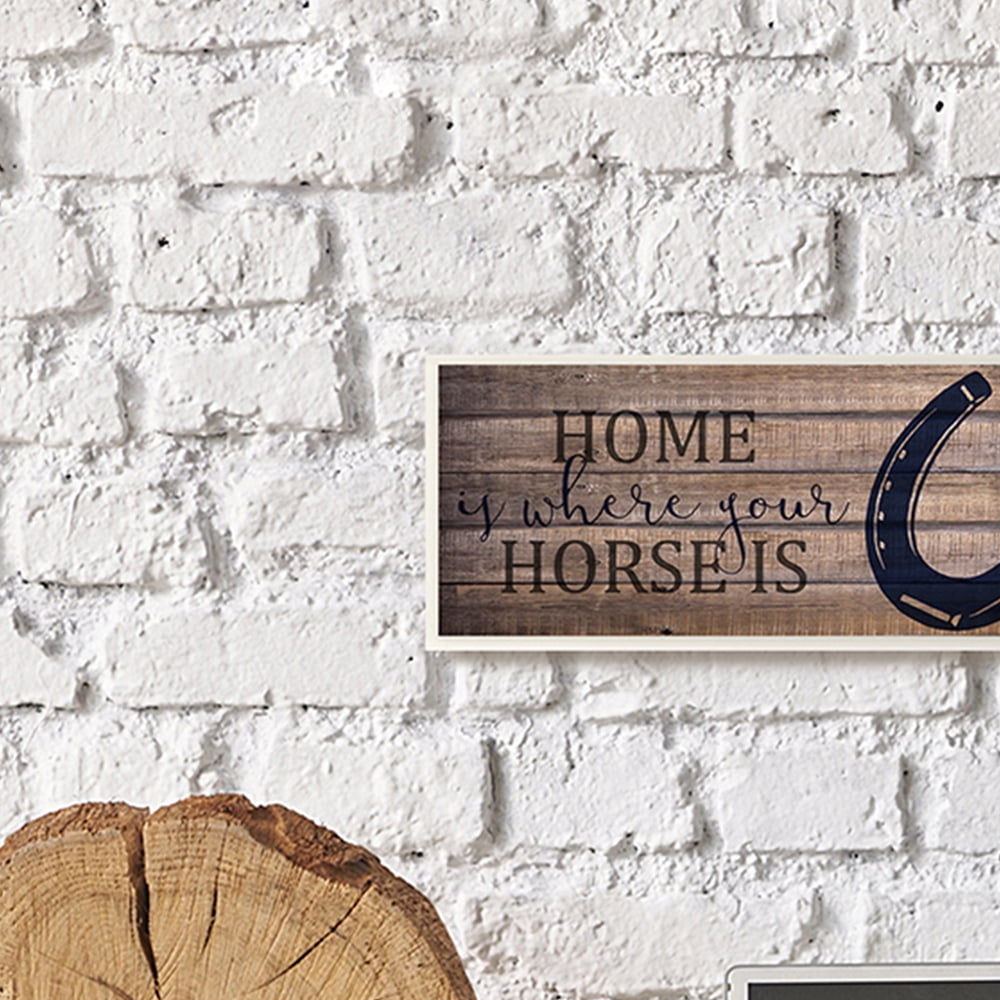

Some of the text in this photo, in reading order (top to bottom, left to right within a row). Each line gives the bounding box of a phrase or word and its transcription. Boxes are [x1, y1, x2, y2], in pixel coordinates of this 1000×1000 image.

[553, 409, 756, 464] HOME
[457, 453, 851, 575] is where your
[502, 539, 808, 594] HORSE IS
